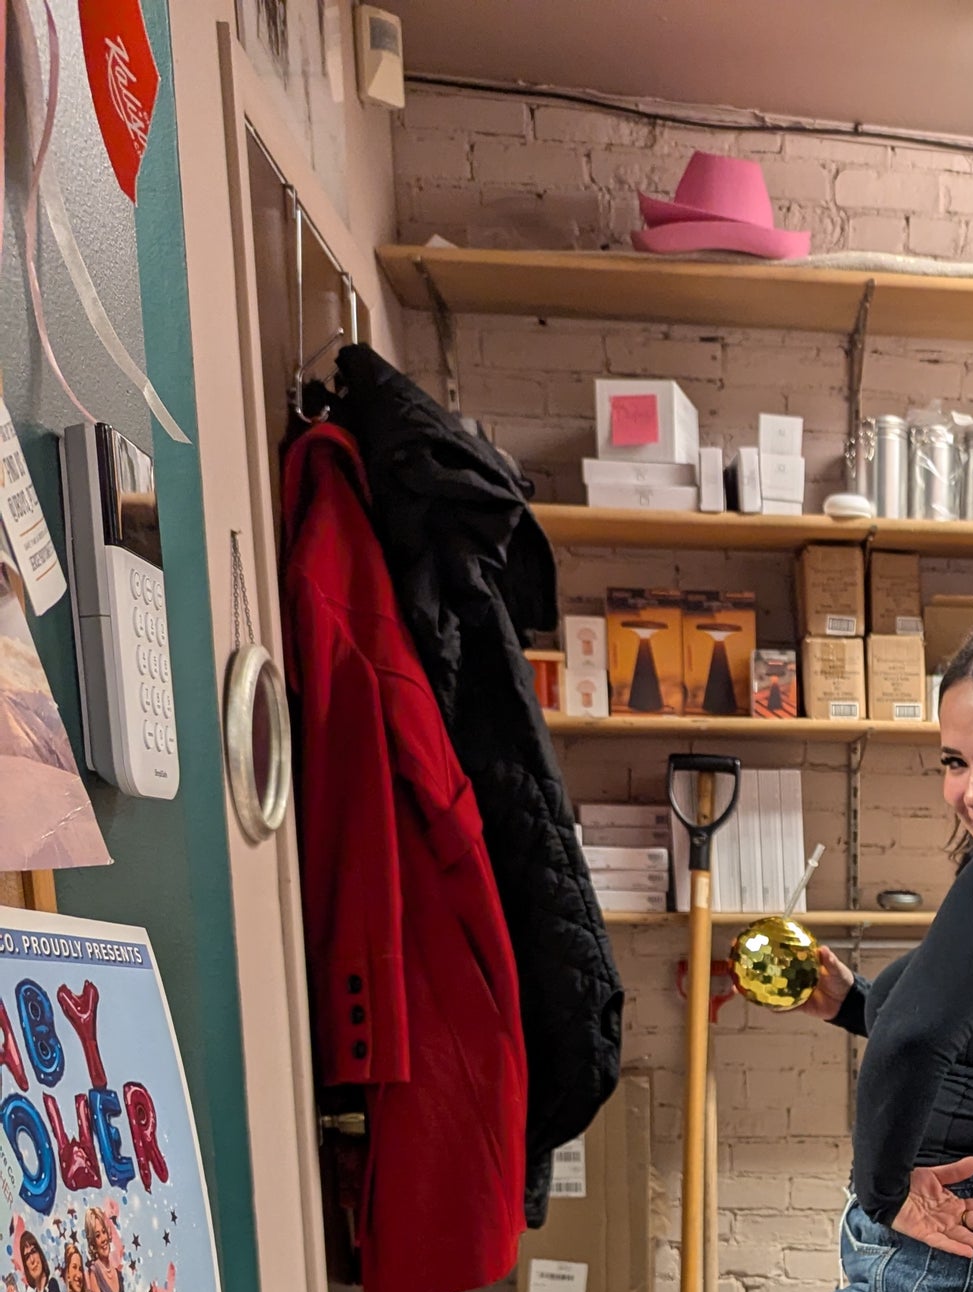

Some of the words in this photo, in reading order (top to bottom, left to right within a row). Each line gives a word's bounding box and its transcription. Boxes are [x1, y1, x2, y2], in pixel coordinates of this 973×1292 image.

[22, 935, 83, 958] PROUDLY
[85, 941, 143, 963] PRESENTS
[0, 1081, 169, 1216] OWER
